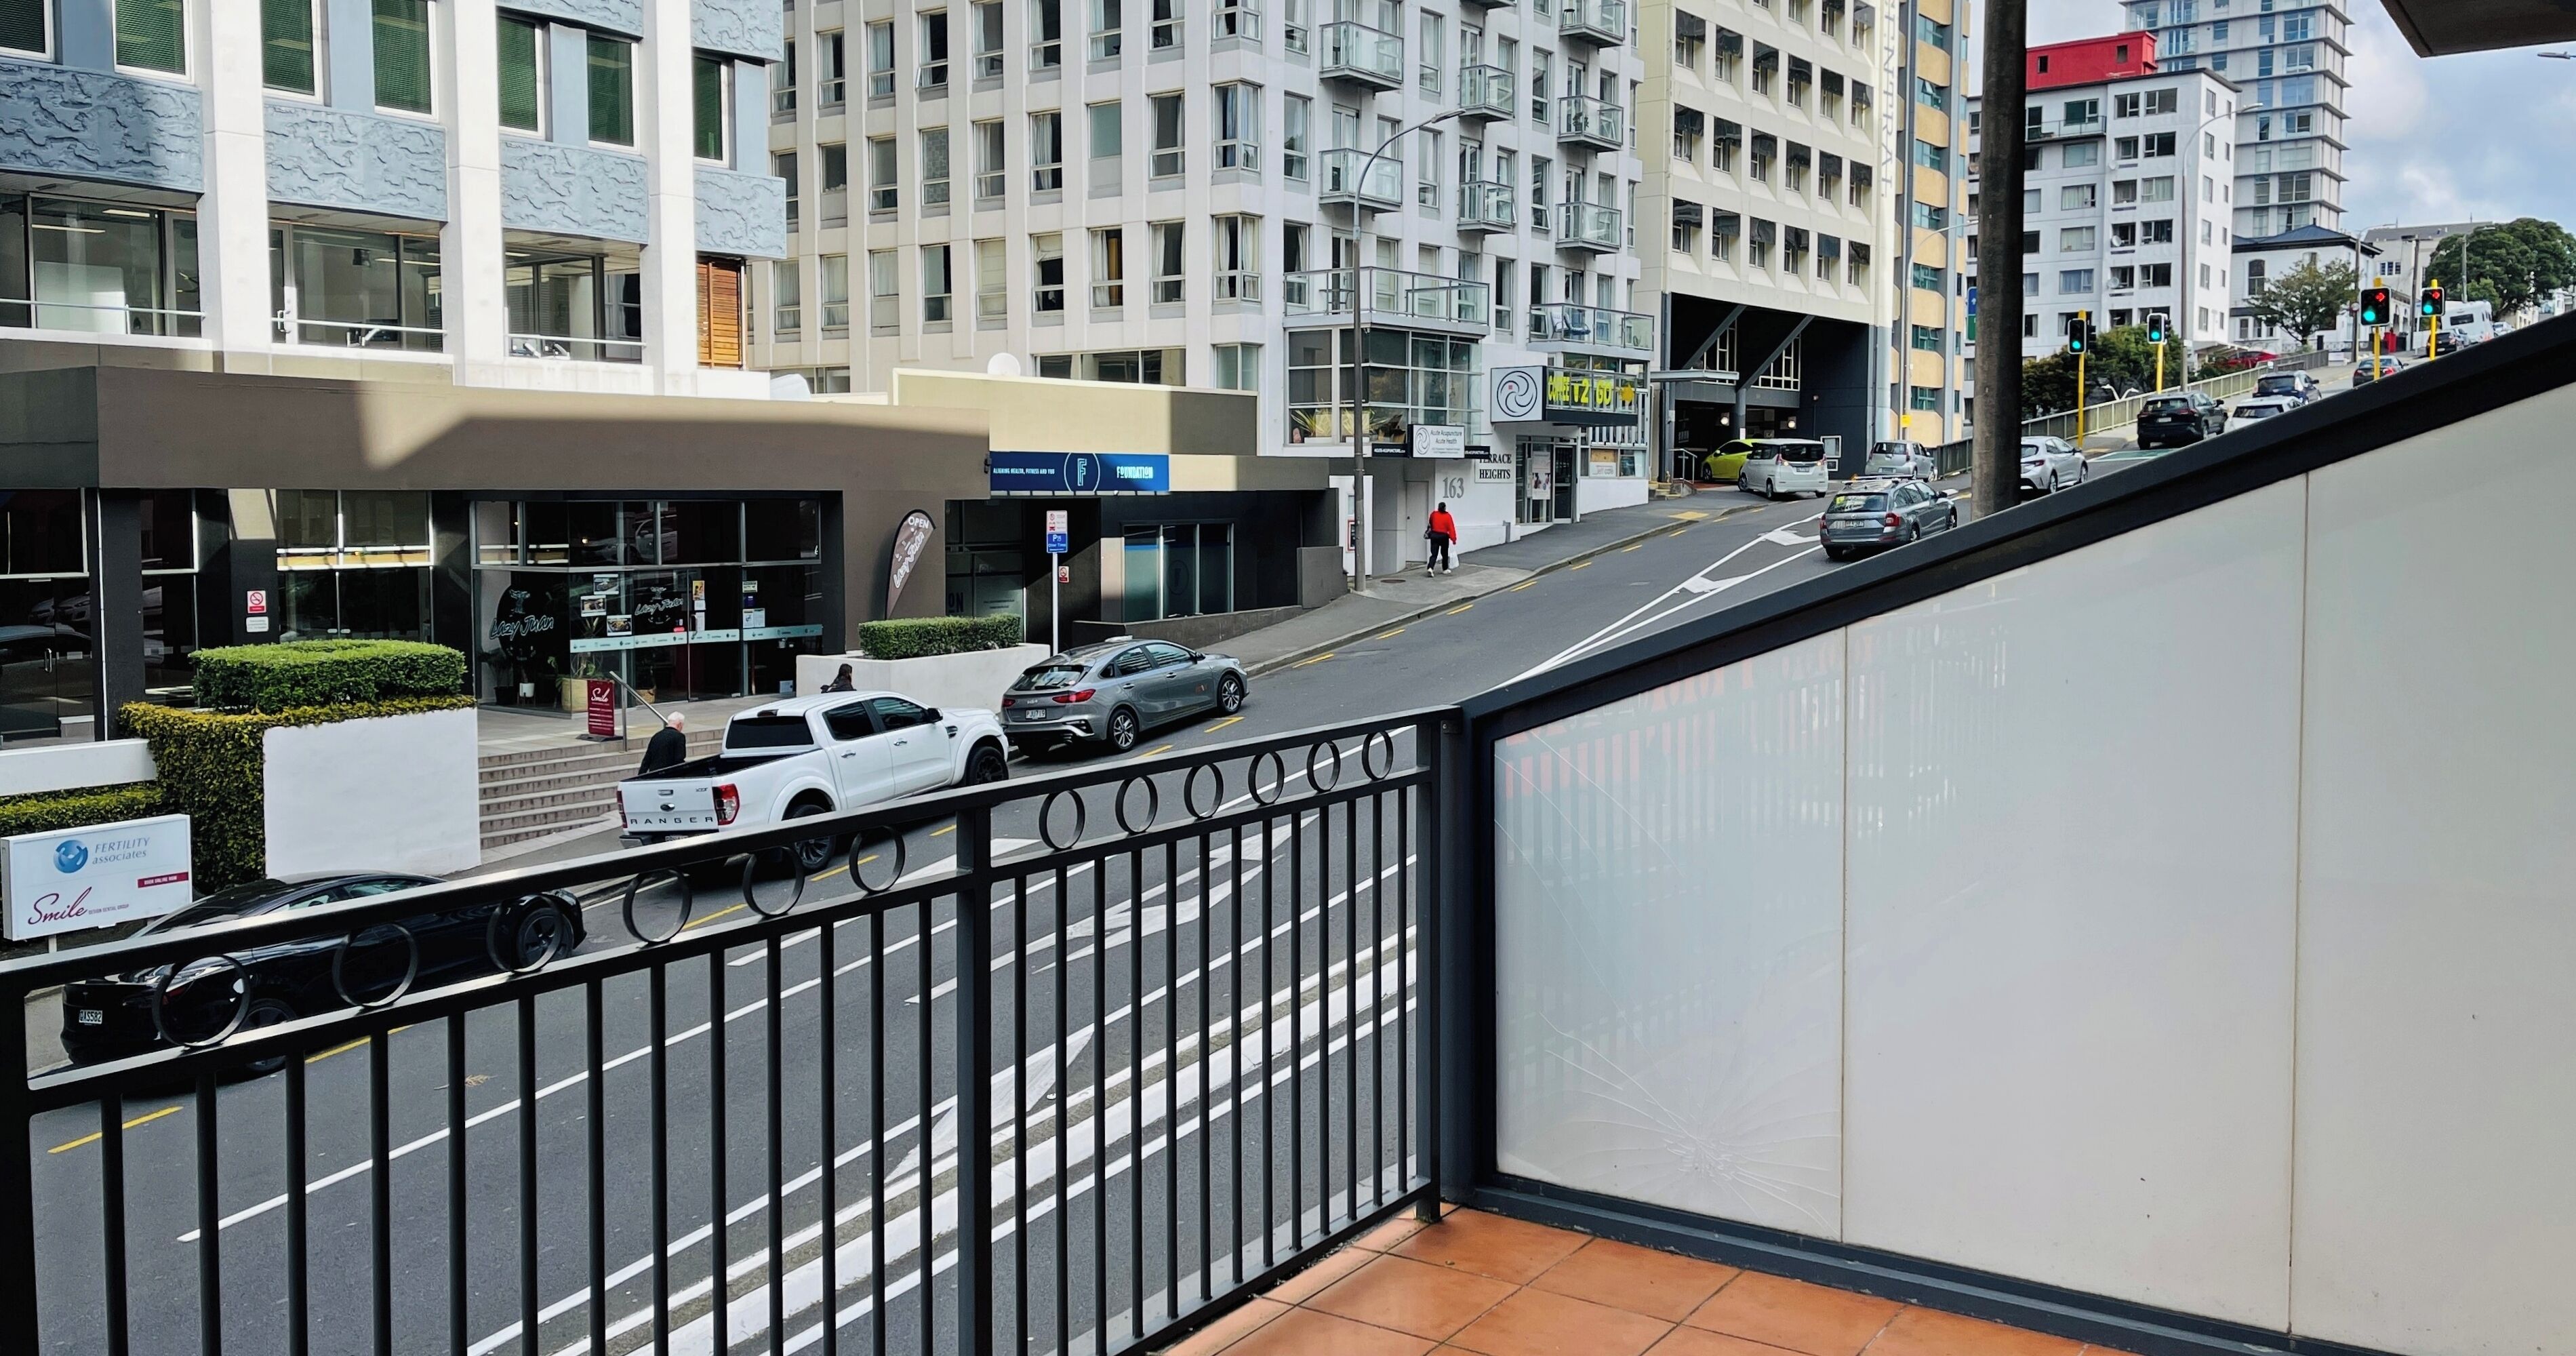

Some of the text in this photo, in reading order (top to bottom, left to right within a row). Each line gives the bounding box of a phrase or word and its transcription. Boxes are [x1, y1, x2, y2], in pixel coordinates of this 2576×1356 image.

[1595, 380, 1612, 405] GO
[1116, 466, 1154, 479] FOUNDATION
[1479, 469, 1511, 479] HEIGHTS
[1443, 477, 1465, 498] 163
[908, 516, 929, 530] OPEN
[634, 603, 661, 616] Lazy
[489, 615, 555, 641] Lazy Juan
[590, 687, 610, 702] Smile
[630, 816, 713, 825] RANGER
[94, 837, 150, 853] FERTILITY
[92, 850, 147, 865] associates
[28, 886, 92, 925] Smile
